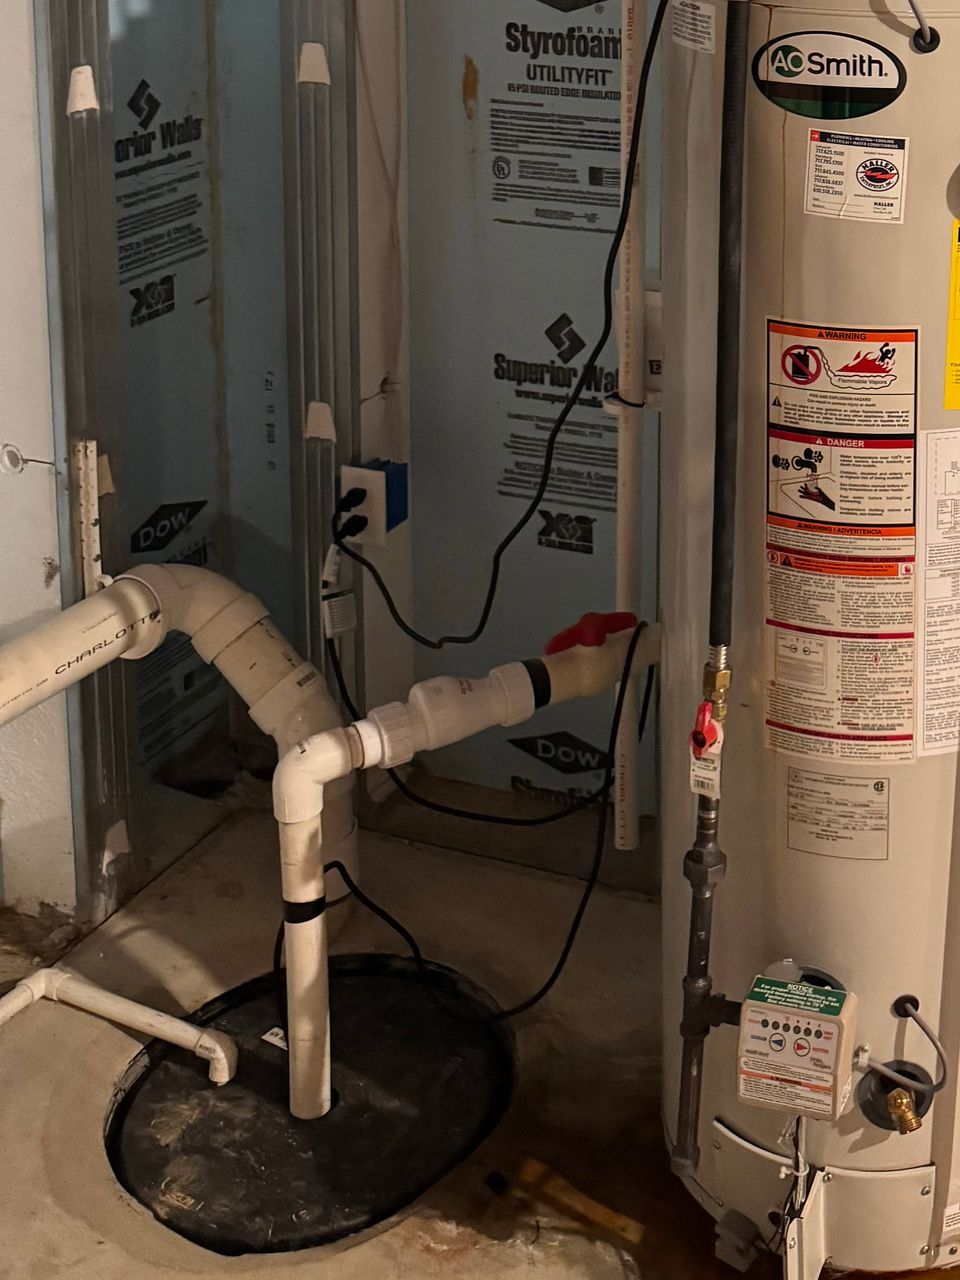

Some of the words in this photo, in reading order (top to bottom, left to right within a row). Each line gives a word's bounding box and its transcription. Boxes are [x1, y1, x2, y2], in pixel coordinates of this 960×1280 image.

[506, 22, 622, 60] Styrofoam
[526, 63, 608, 86] UTILITYFIT
[773, 50, 805, 73] AO
[808, 52, 884, 77] Smith
[861, 160, 895, 172] HALLER
[825, 331, 867, 340] WARNING
[827, 439, 865, 448] DANGER
[139, 508, 192, 547] DOW
[537, 739, 599, 768] DOW
[787, 983, 813, 993] NOTICE
